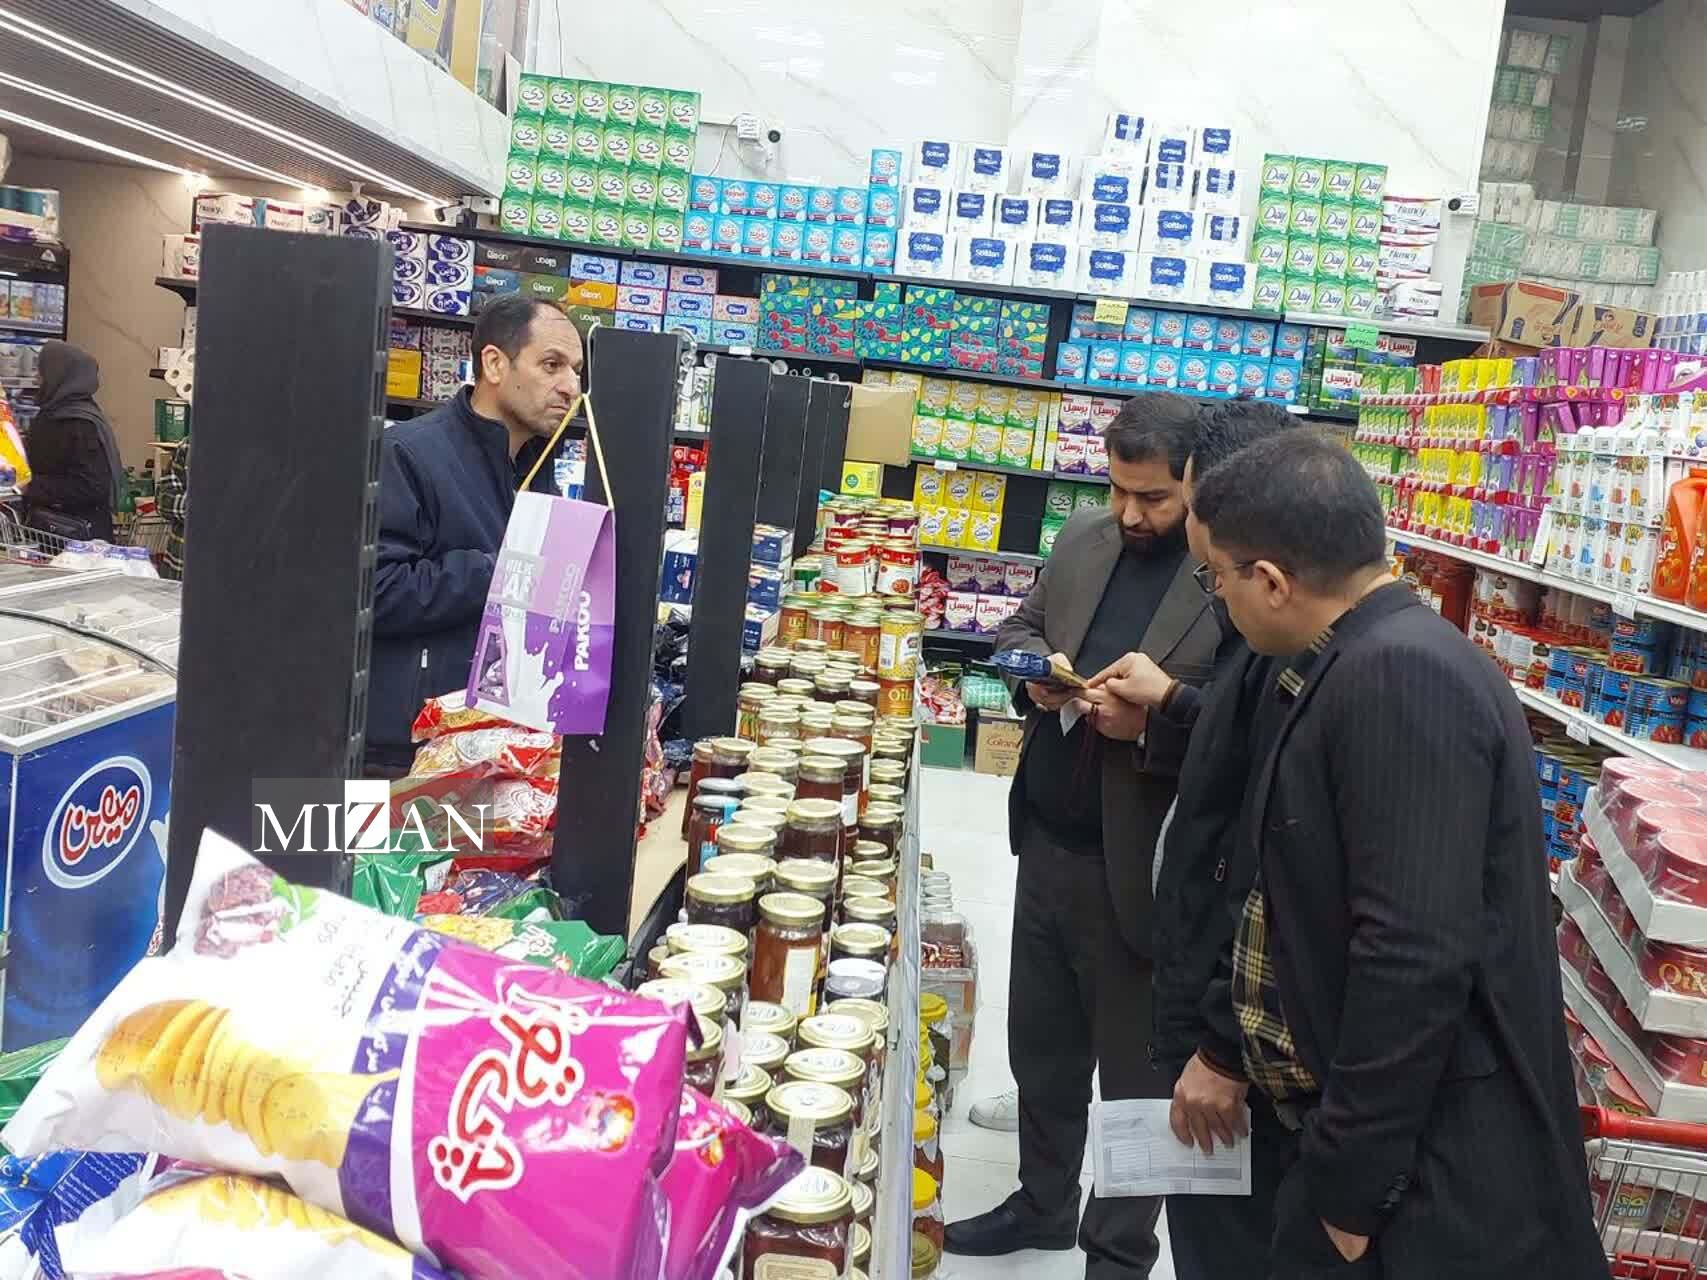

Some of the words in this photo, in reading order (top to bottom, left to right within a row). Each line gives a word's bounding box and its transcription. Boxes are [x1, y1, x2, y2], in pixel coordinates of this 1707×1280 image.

[522, 88, 544, 102] دی
[552, 91, 575, 105] دی
[583, 95, 605, 108] دی
[613, 97, 635, 111] دی
[643, 101, 665, 114] دی
[673, 104, 695, 117] دی
[516, 128, 537, 142] دی
[547, 131, 568, 144] دی
[577, 134, 599, 147] دی
[607, 137, 630, 151] دی
[637, 141, 660, 154] دی
[667, 144, 689, 157] دی
[511, 167, 532, 181] دی
[541, 170, 563, 183] دی
[571, 174, 593, 187] دی
[1266, 168, 1289, 184] Day
[1297, 171, 1320, 187] Day
[601, 177, 624, 191] دی
[632, 182, 654, 195] دی
[1328, 174, 1351, 190] Day
[1359, 177, 1382, 193] Day
[662, 185, 683, 197] دی
[505, 207, 527, 221] دی
[536, 210, 559, 224] دی
[567, 214, 589, 227] دی
[1264, 206, 1287, 221] Day
[1295, 208, 1318, 224] Day
[1325, 212, 1348, 228] Day
[597, 217, 619, 232] دی
[627, 221, 649, 234] دی
[1355, 216, 1377, 231] Day
[657, 225, 679, 238] دی
[1260, 245, 1284, 262] Day
[1292, 248, 1315, 265] Day
[1323, 252, 1344, 268] Day
[1351, 255, 1374, 271] Day
[1257, 285, 1280, 301] Day
[1288, 286, 1311, 304] Day
[1318, 289, 1341, 306] Day
[1350, 294, 1372, 310] Day
[60, 785, 141, 866] میهن
